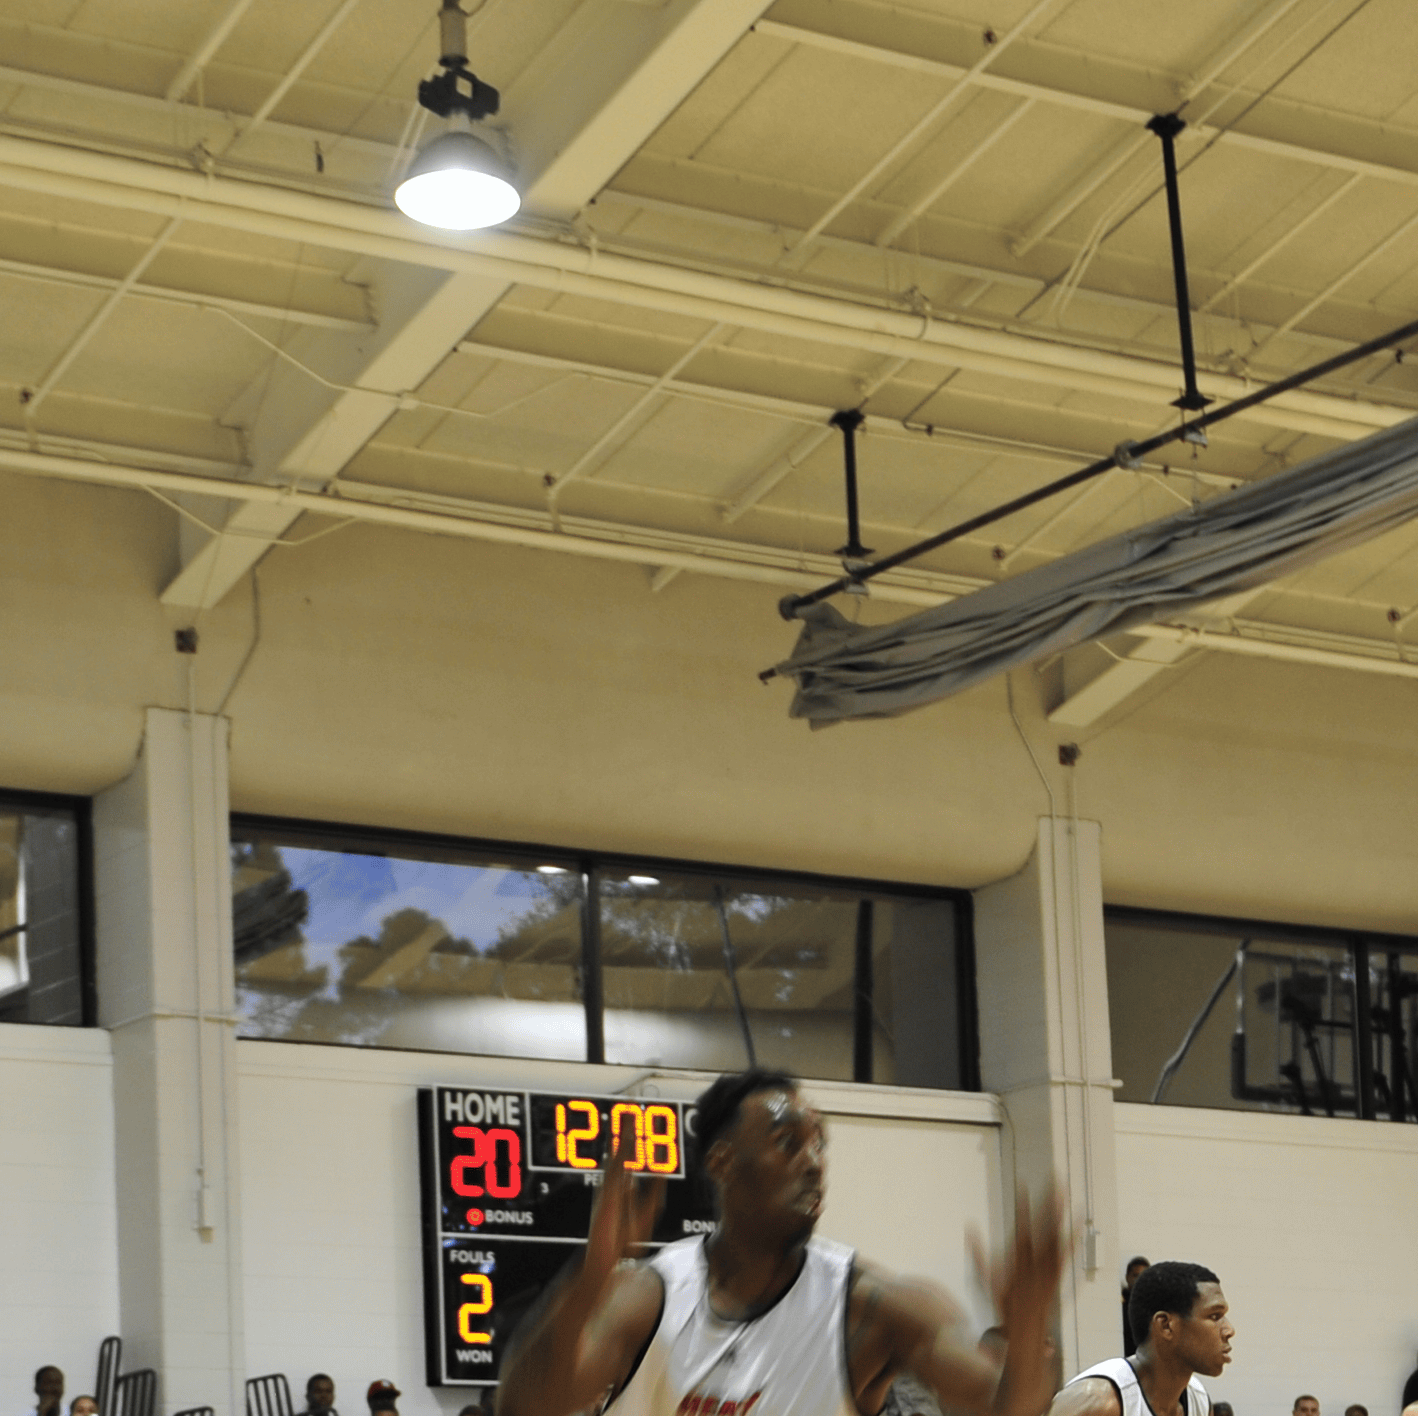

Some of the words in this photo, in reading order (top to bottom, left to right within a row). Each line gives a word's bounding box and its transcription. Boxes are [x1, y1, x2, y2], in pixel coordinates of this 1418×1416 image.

[444, 1091, 521, 1126] HOME
[450, 1126, 522, 1199] 20
[485, 1209, 534, 1225] BONUS
[449, 1249, 496, 1264] FOULS
[457, 1273, 494, 1344] 2
[456, 1349, 493, 1363] WON
